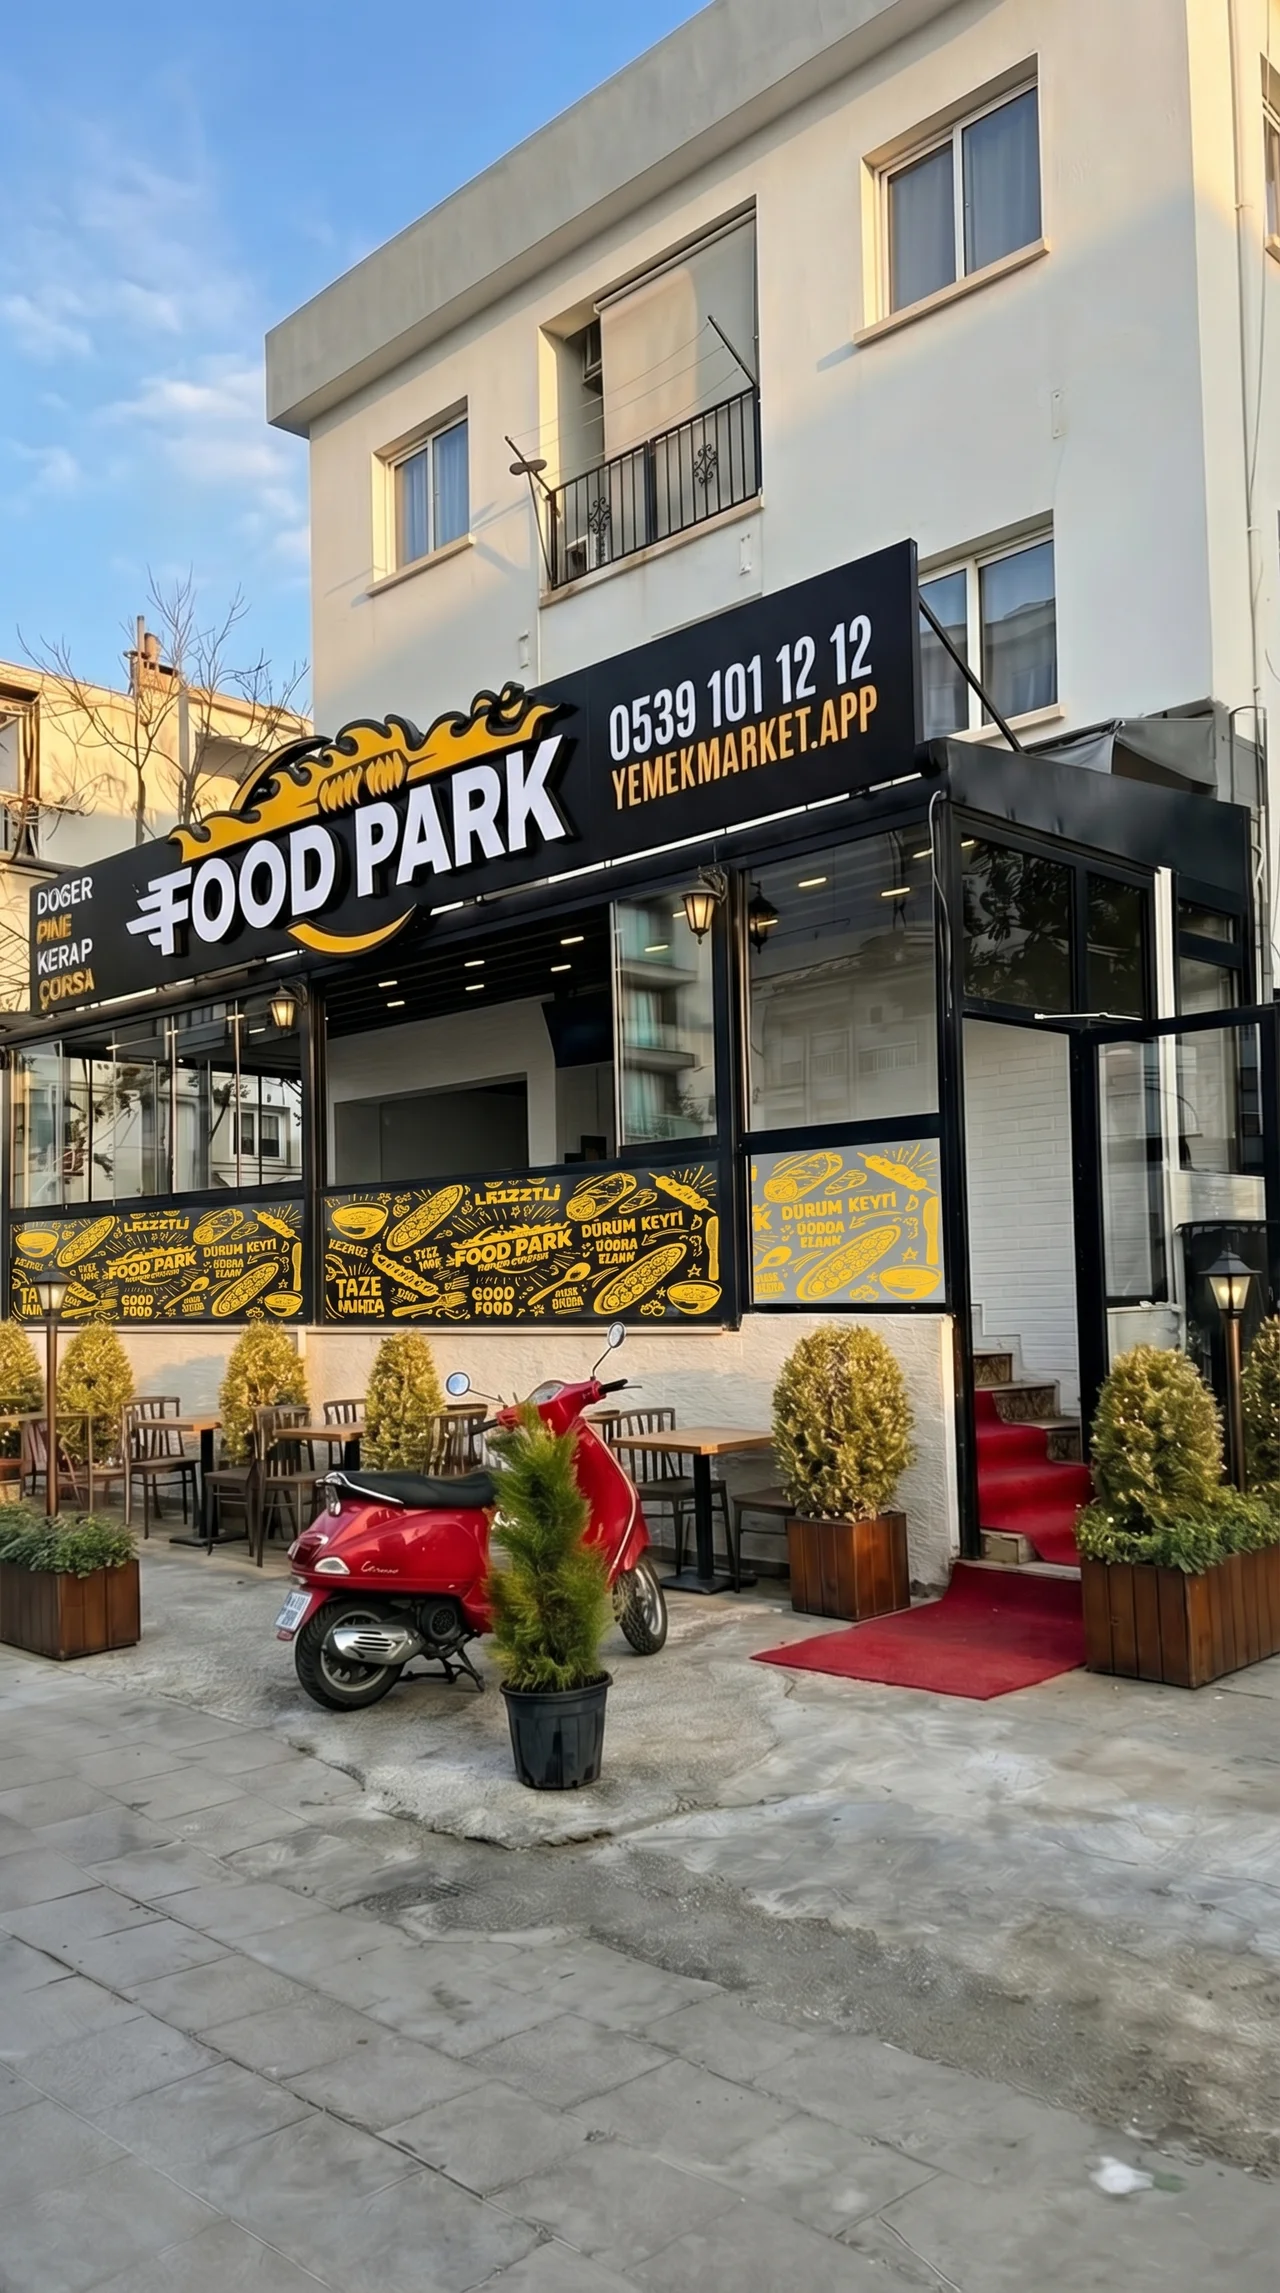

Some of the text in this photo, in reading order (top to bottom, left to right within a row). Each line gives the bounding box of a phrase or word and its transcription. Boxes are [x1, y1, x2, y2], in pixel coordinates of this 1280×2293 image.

[609, 614, 872, 761] 0539 101 12 12
[611, 684, 878, 810] YEMEKMARKET.APP
[125, 733, 566, 956] FOOD PARK
[37, 938, 93, 975] KERAP
[454, 1242, 511, 1267] FOOD
[515, 1228, 573, 1256] PARK
[108, 1260, 151, 1280] FOOD
[154, 1250, 197, 1272] PARK
[20, 1287, 38, 1303] TA
[121, 1294, 153, 1306] GOOD
[335, 1276, 382, 1298] TAZE
[471, 1286, 515, 1301] GOOD
[123, 1306, 152, 1317] FOOD
[475, 1301, 513, 1315] FOOD
